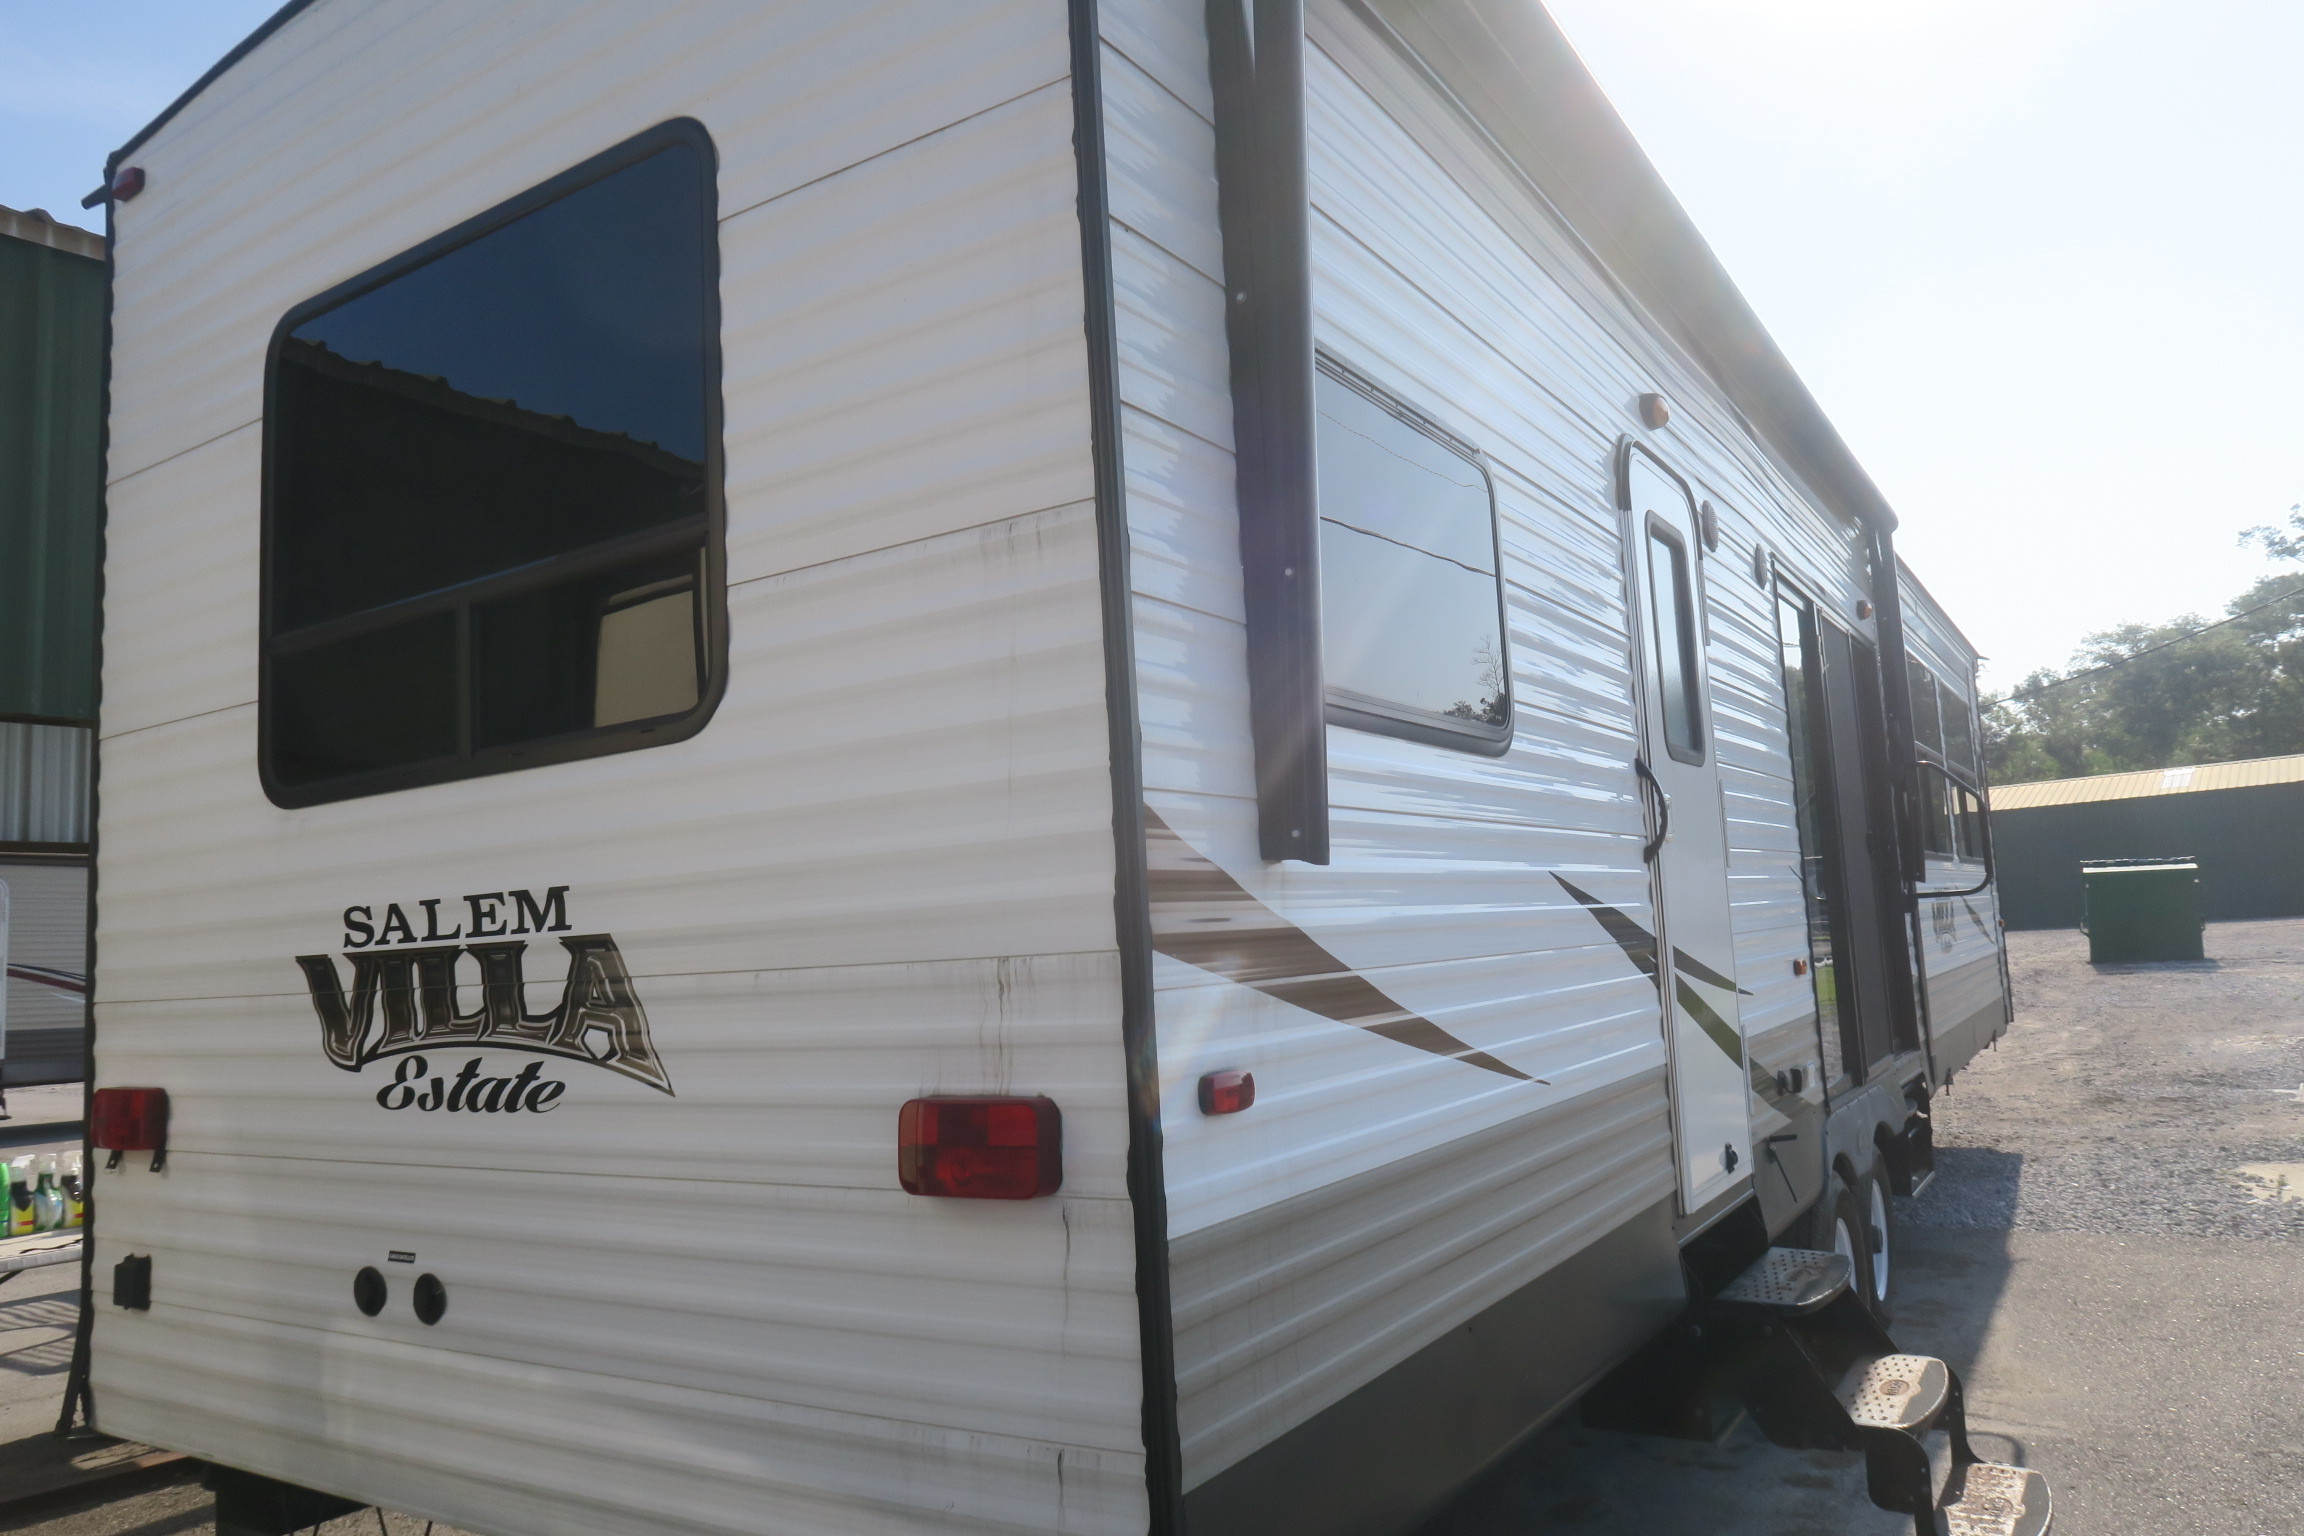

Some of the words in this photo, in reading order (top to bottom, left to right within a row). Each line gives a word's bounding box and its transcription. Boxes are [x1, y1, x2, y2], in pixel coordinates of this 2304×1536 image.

[343, 885, 572, 948] SALEM
[295, 933, 676, 1097] VILLA
[376, 1055, 566, 1113] Estate
